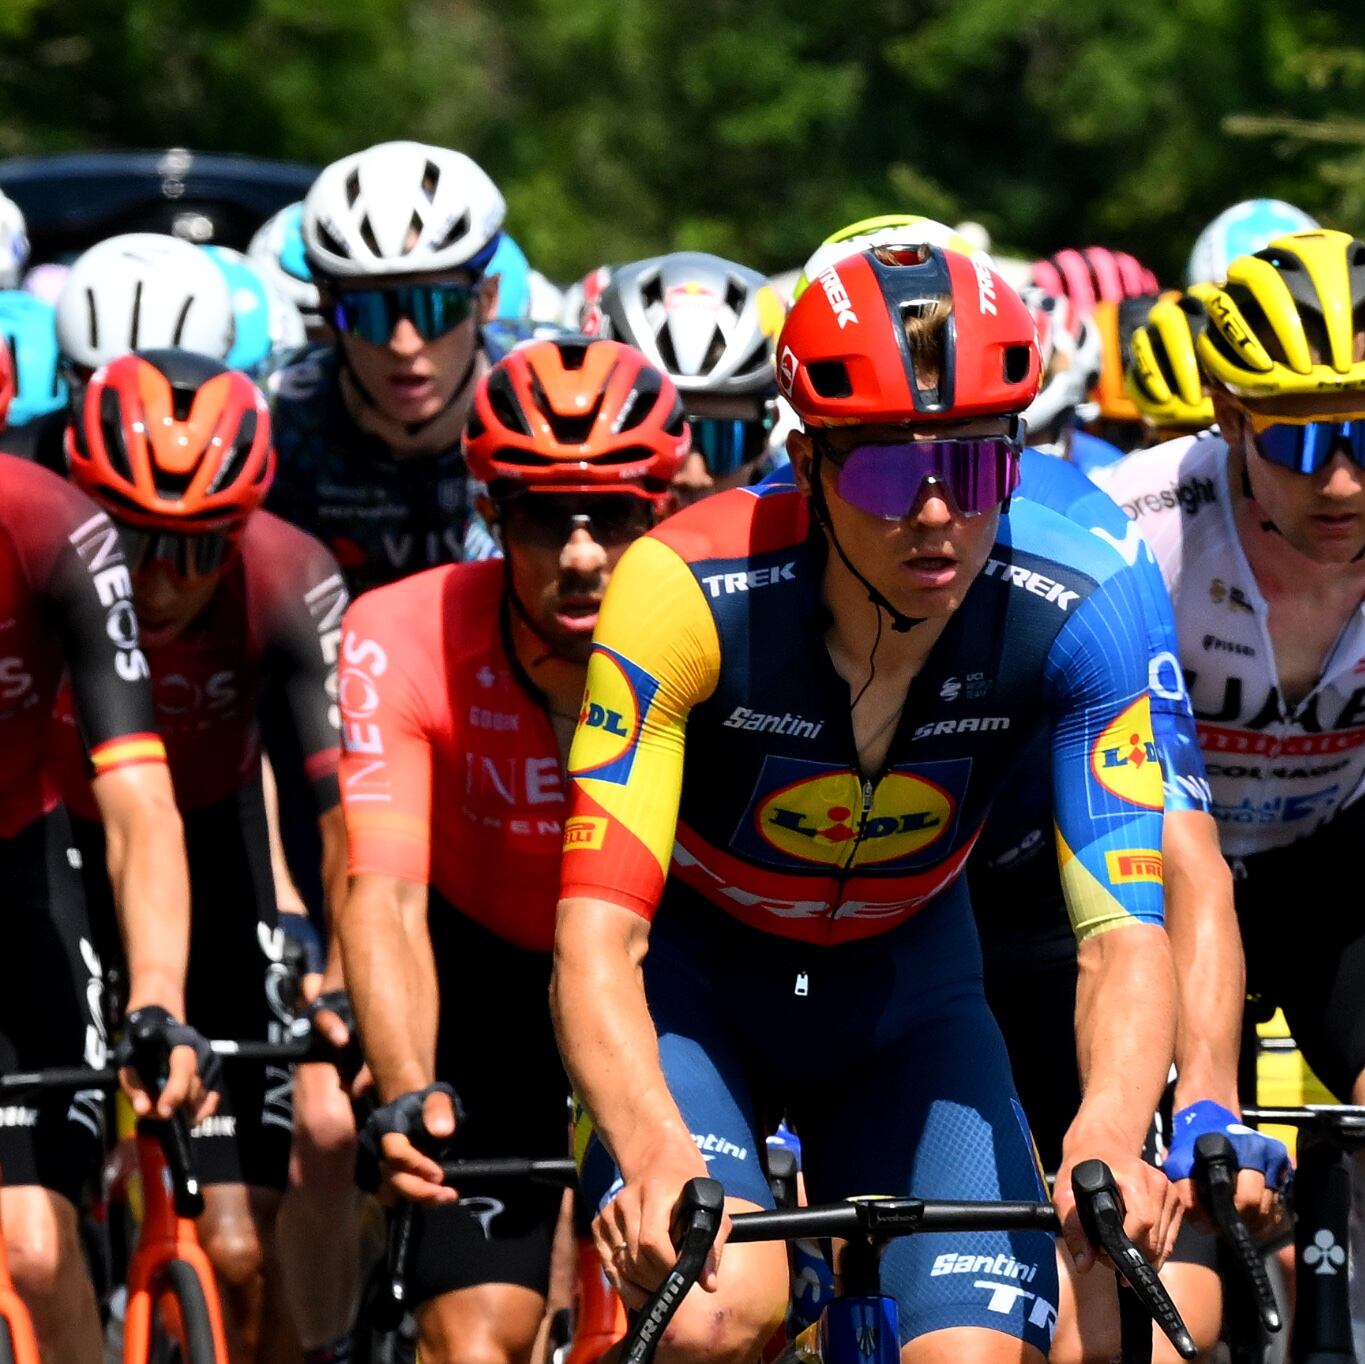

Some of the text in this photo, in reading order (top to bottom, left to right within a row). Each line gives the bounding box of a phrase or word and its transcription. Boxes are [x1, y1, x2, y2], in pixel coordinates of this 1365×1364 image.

[817, 266, 860, 330] TREK
[1213, 296, 1254, 349] MET
[69, 512, 151, 682] INEOS
[702, 561, 796, 599] TREK
[984, 557, 1081, 612] TREK
[345, 630, 392, 803] INEOS
[723, 706, 825, 740] Santini
[912, 717, 1010, 741] SRAM
[930, 1253, 1038, 1285] Santini
[631, 1270, 686, 1362] SRAM
